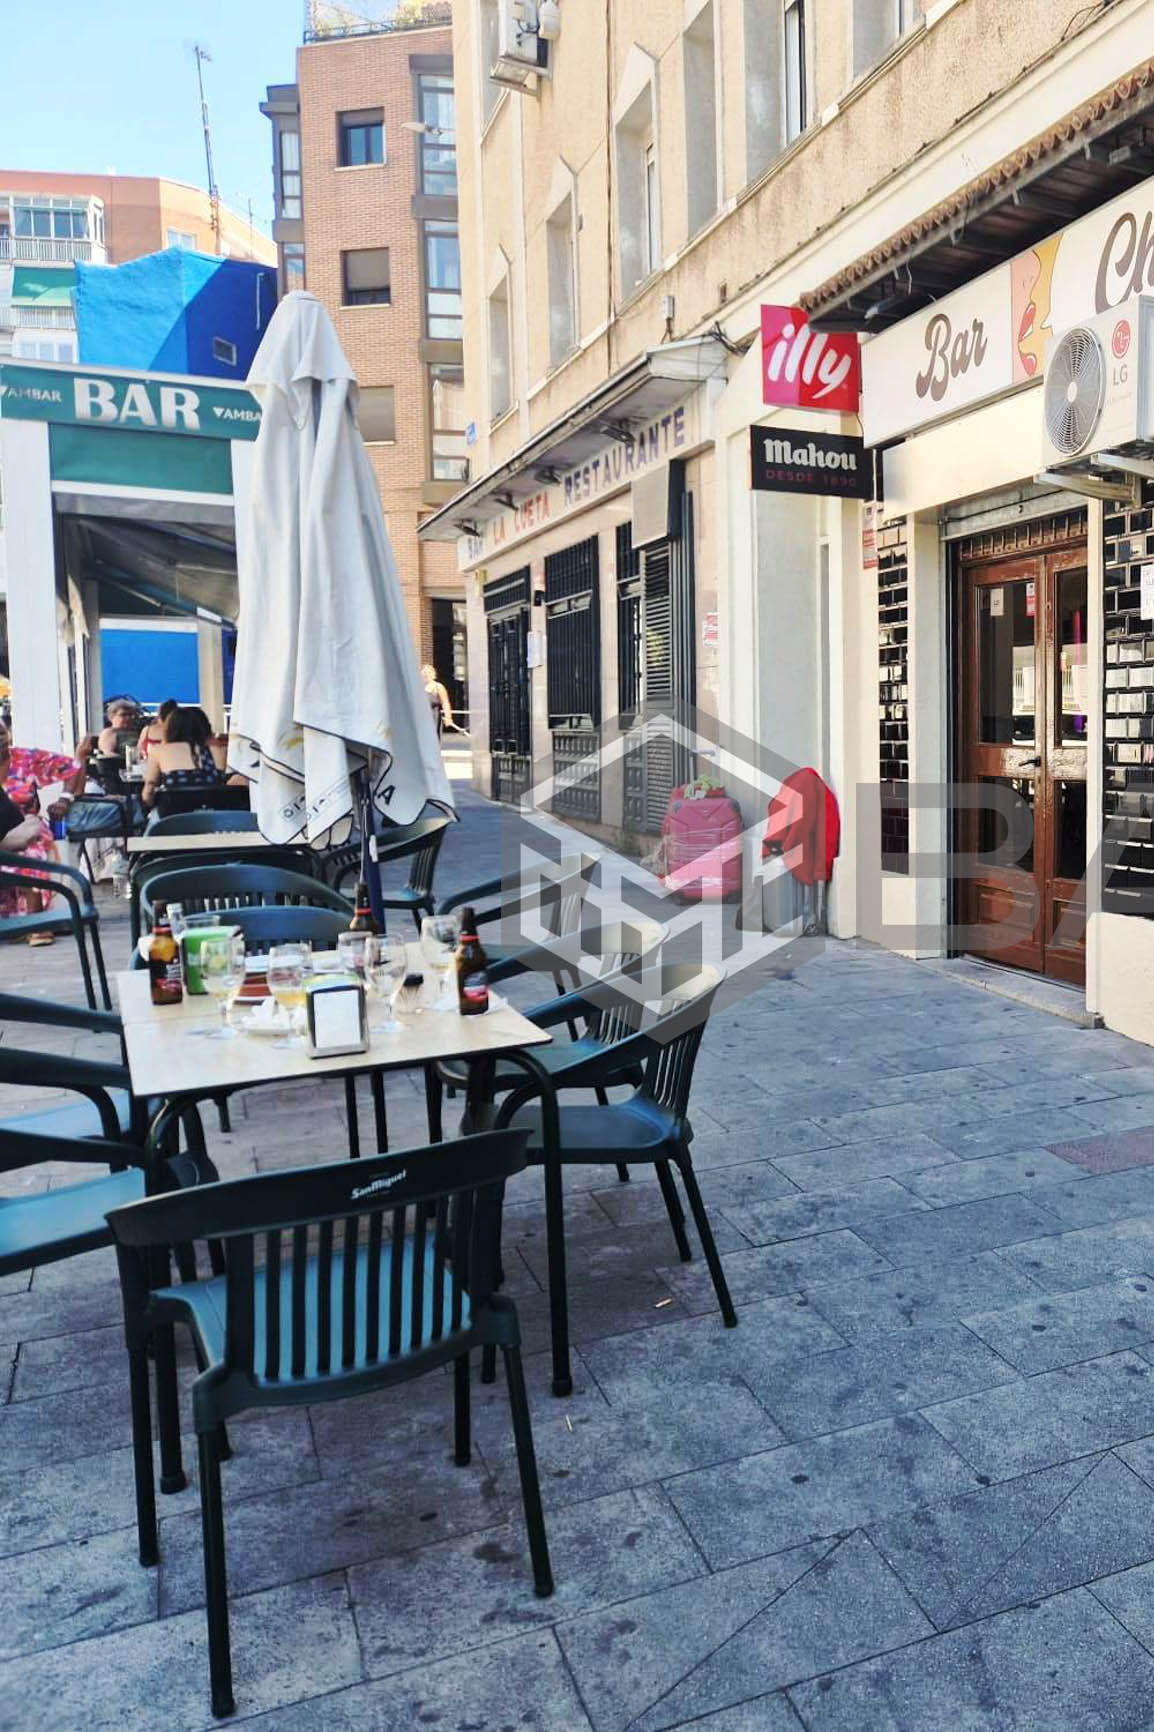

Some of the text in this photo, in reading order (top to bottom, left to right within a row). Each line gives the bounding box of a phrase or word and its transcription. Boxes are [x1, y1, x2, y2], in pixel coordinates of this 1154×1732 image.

[768, 323, 852, 399] illy
[916, 313, 988, 402] Bar
[1112, 364, 1128, 386] LG
[74, 377, 201, 430] BAR
[224, 408, 262, 422] AMBA
[565, 406, 685, 507] RESTAURANTE
[763, 438, 858, 470] Mahou
